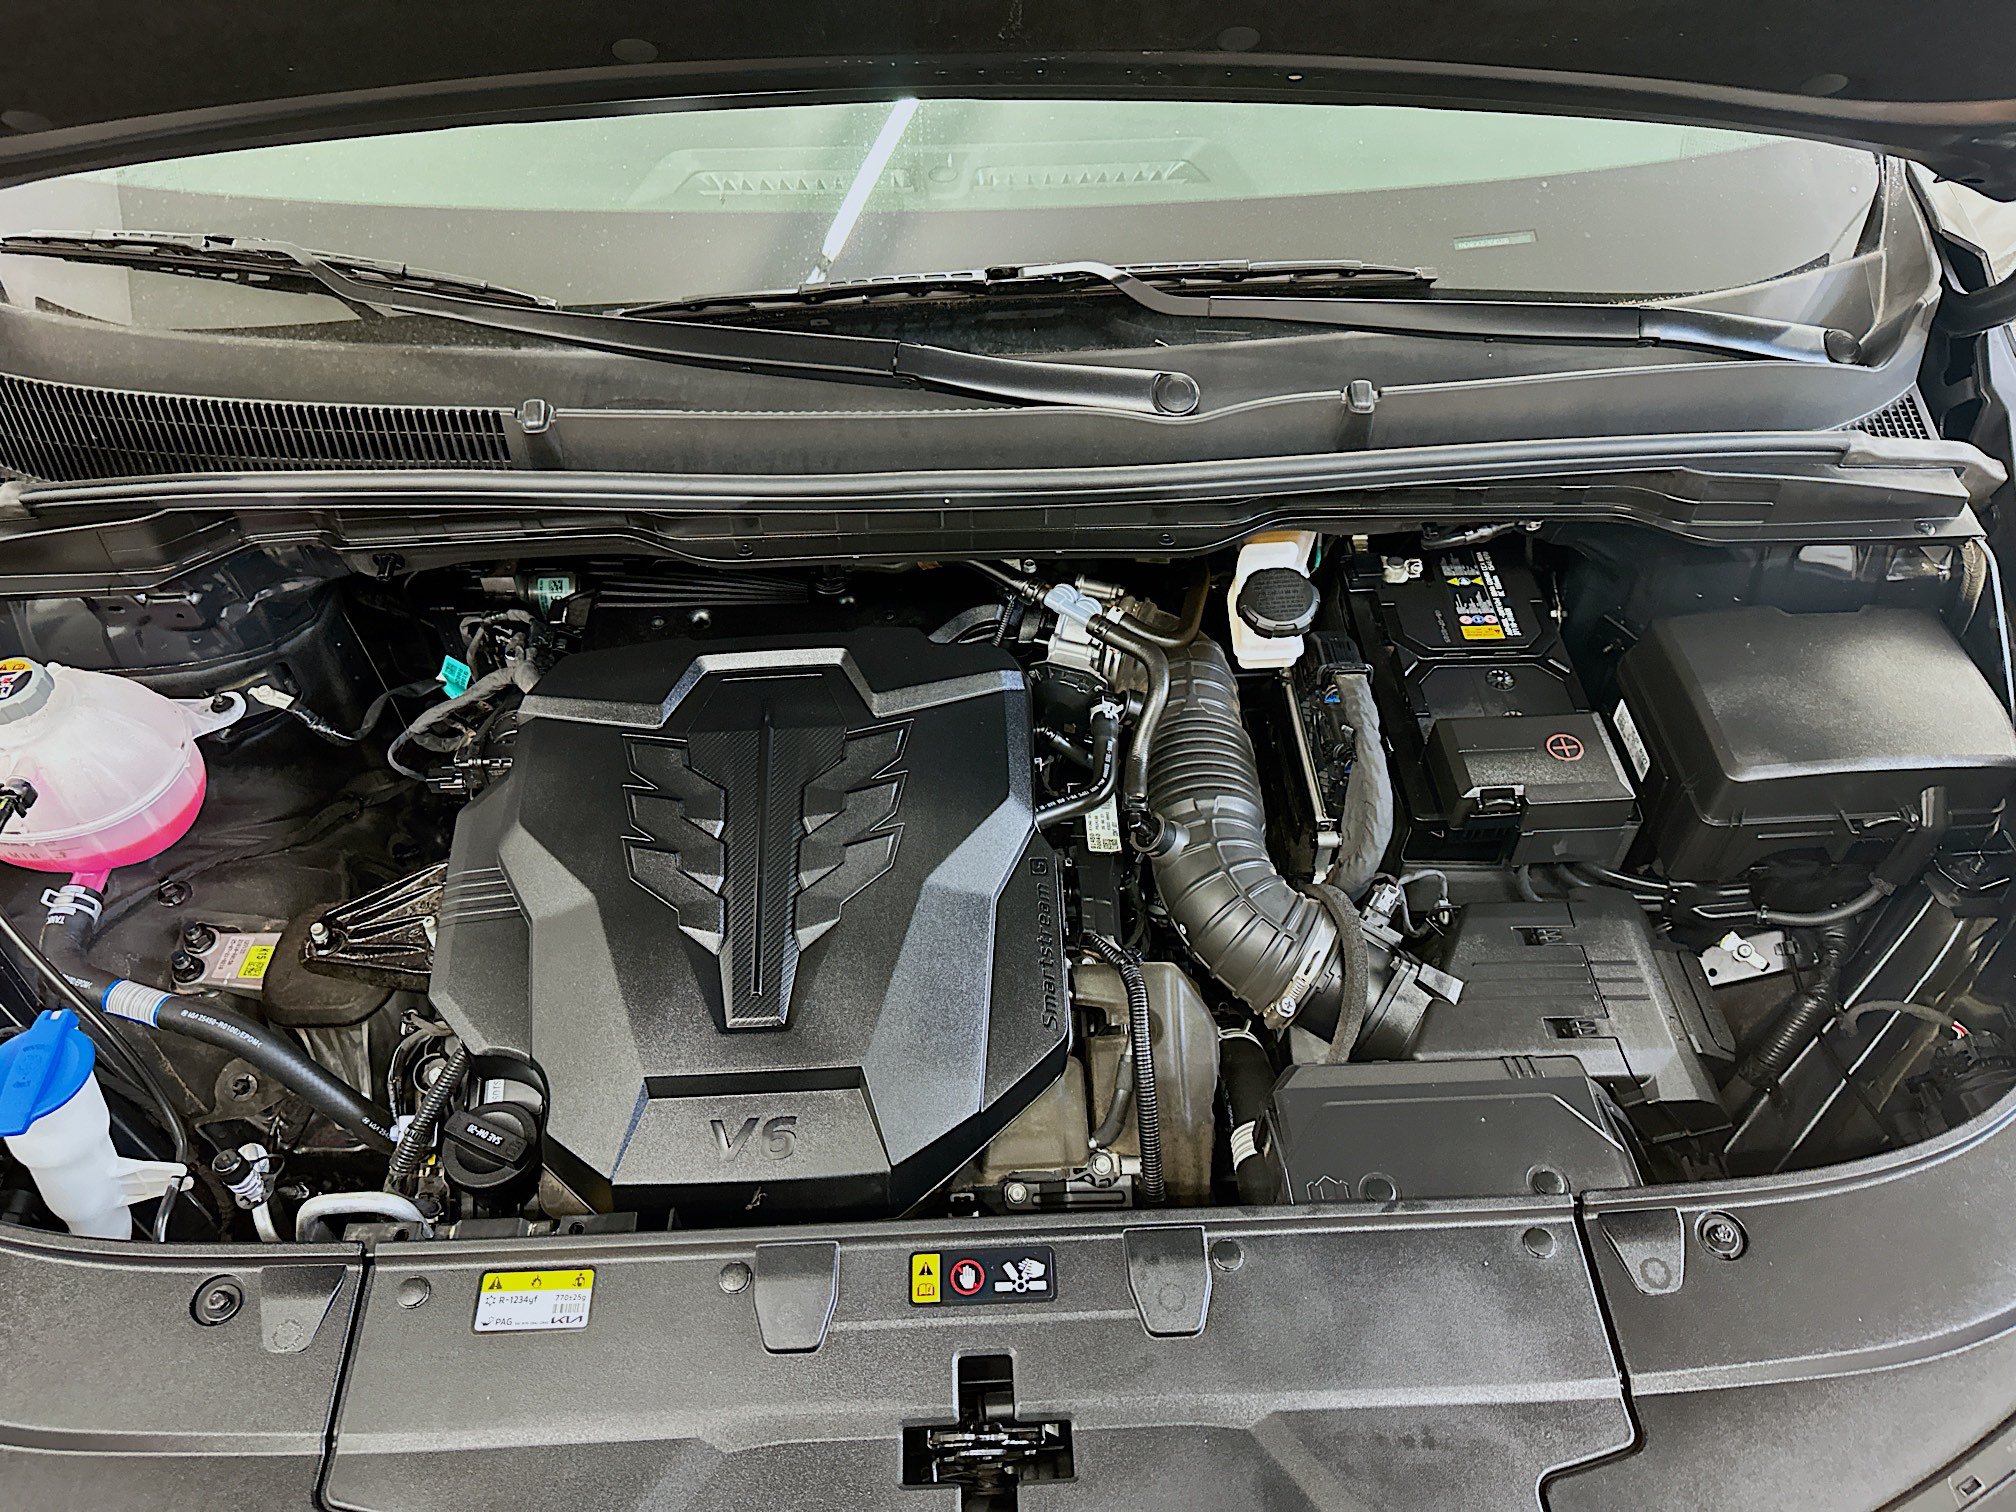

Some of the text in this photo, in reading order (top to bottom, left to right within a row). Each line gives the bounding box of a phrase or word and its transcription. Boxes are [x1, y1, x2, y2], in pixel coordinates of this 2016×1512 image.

[1037, 882, 1059, 1031] Smartstream
[487, 1131, 503, 1146] SAE
[709, 1115, 798, 1162] V6
[498, 1293, 587, 1305] R-1234yf 770±25g
[495, 1317, 513, 1326] PAG
[551, 1315, 583, 1324] KIA
